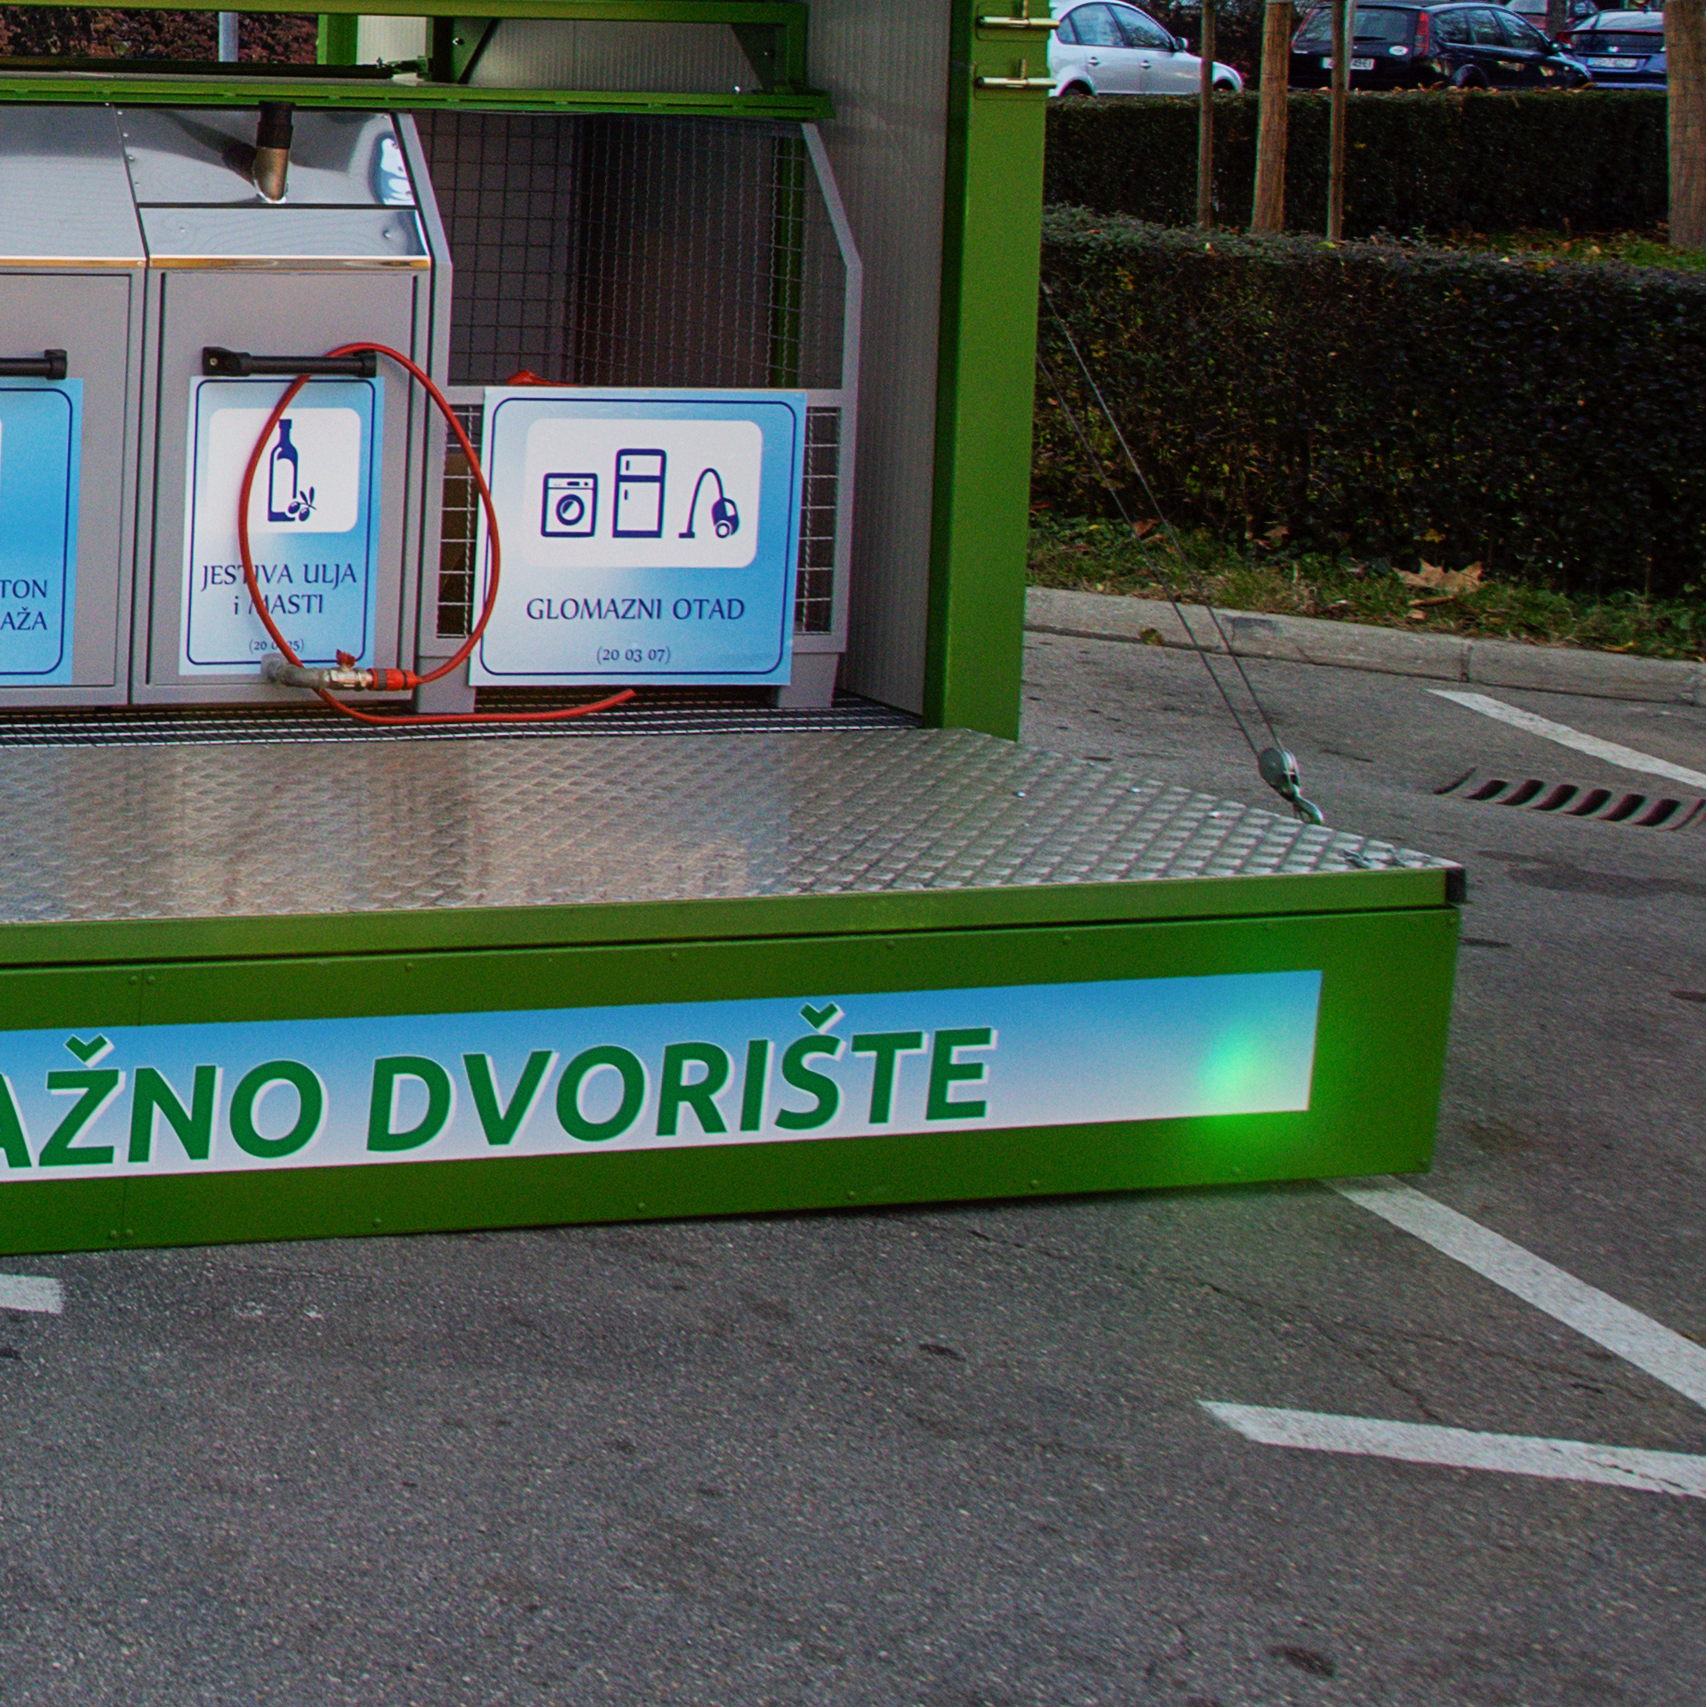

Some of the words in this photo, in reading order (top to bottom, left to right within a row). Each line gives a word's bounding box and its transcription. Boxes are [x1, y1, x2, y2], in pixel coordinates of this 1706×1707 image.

[201, 564, 293, 592] JESTIVA
[303, 563, 357, 590] ULJA
[234, 595, 239, 615] i
[248, 594, 323, 614] MASTI
[526, 597, 662, 622] GLOMAZNI
[672, 597, 745, 621] OTAD
[249, 639, 267, 654] (20
[596, 646, 619, 665] (20
[625, 648, 644, 664] 03
[646, 646, 671, 665] 07)
[366, 1000, 993, 1155] DVORIŠTE
